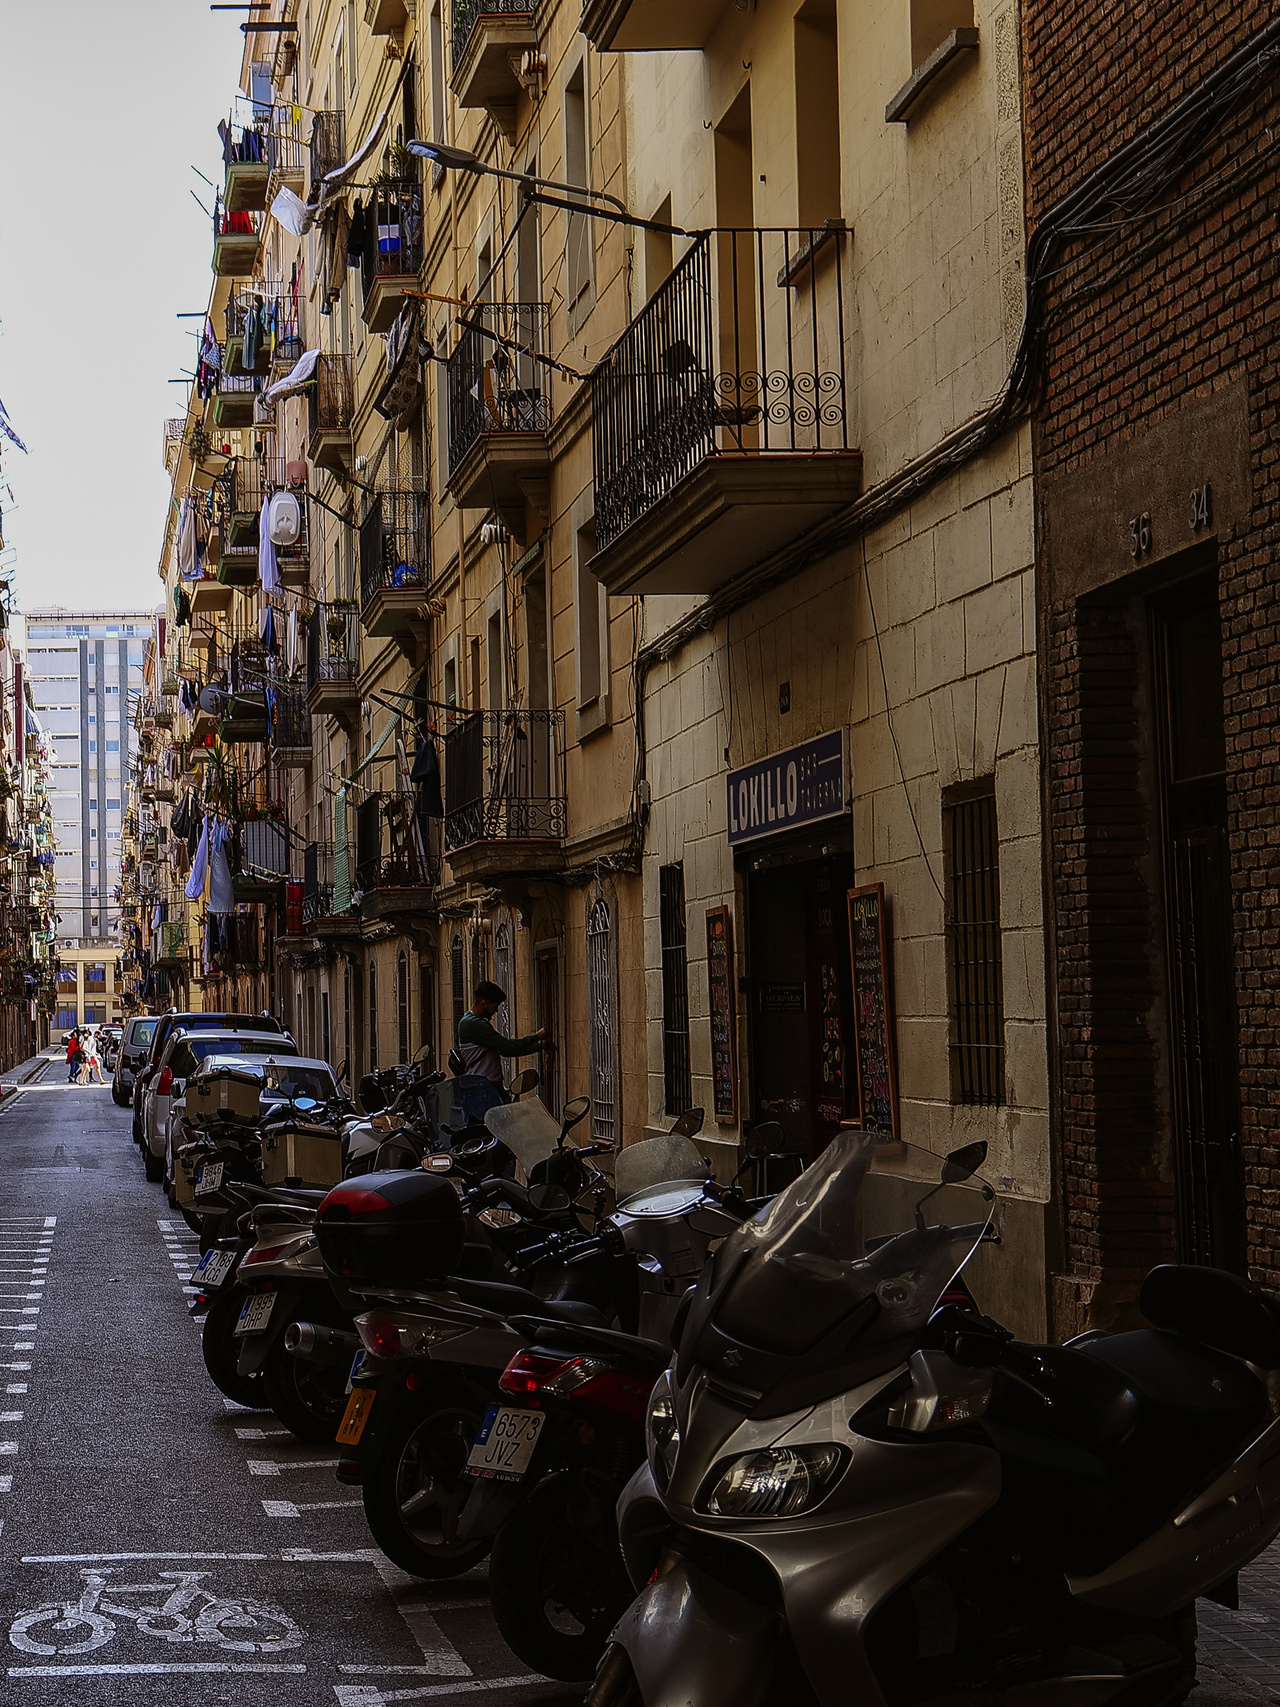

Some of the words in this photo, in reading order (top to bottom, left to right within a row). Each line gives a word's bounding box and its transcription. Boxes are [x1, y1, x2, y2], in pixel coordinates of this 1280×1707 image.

[1129, 511, 1152, 557] 36
[1188, 484, 1208, 529] 34
[801, 752, 818, 781] BAR
[730, 761, 797, 833] LOKILLO
[800, 777, 841, 812] TAVERNA
[204, 1164, 222, 1178] 9846
[209, 1252, 234, 1268] 2188
[201, 1266, 221, 1282] KCG
[250, 1293, 275, 1312] 1995
[242, 1312, 263, 1329] DHP
[480, 1428, 488, 1438] E
[495, 1413, 541, 1441] 6573
[484, 1440, 521, 1467] JVZ
